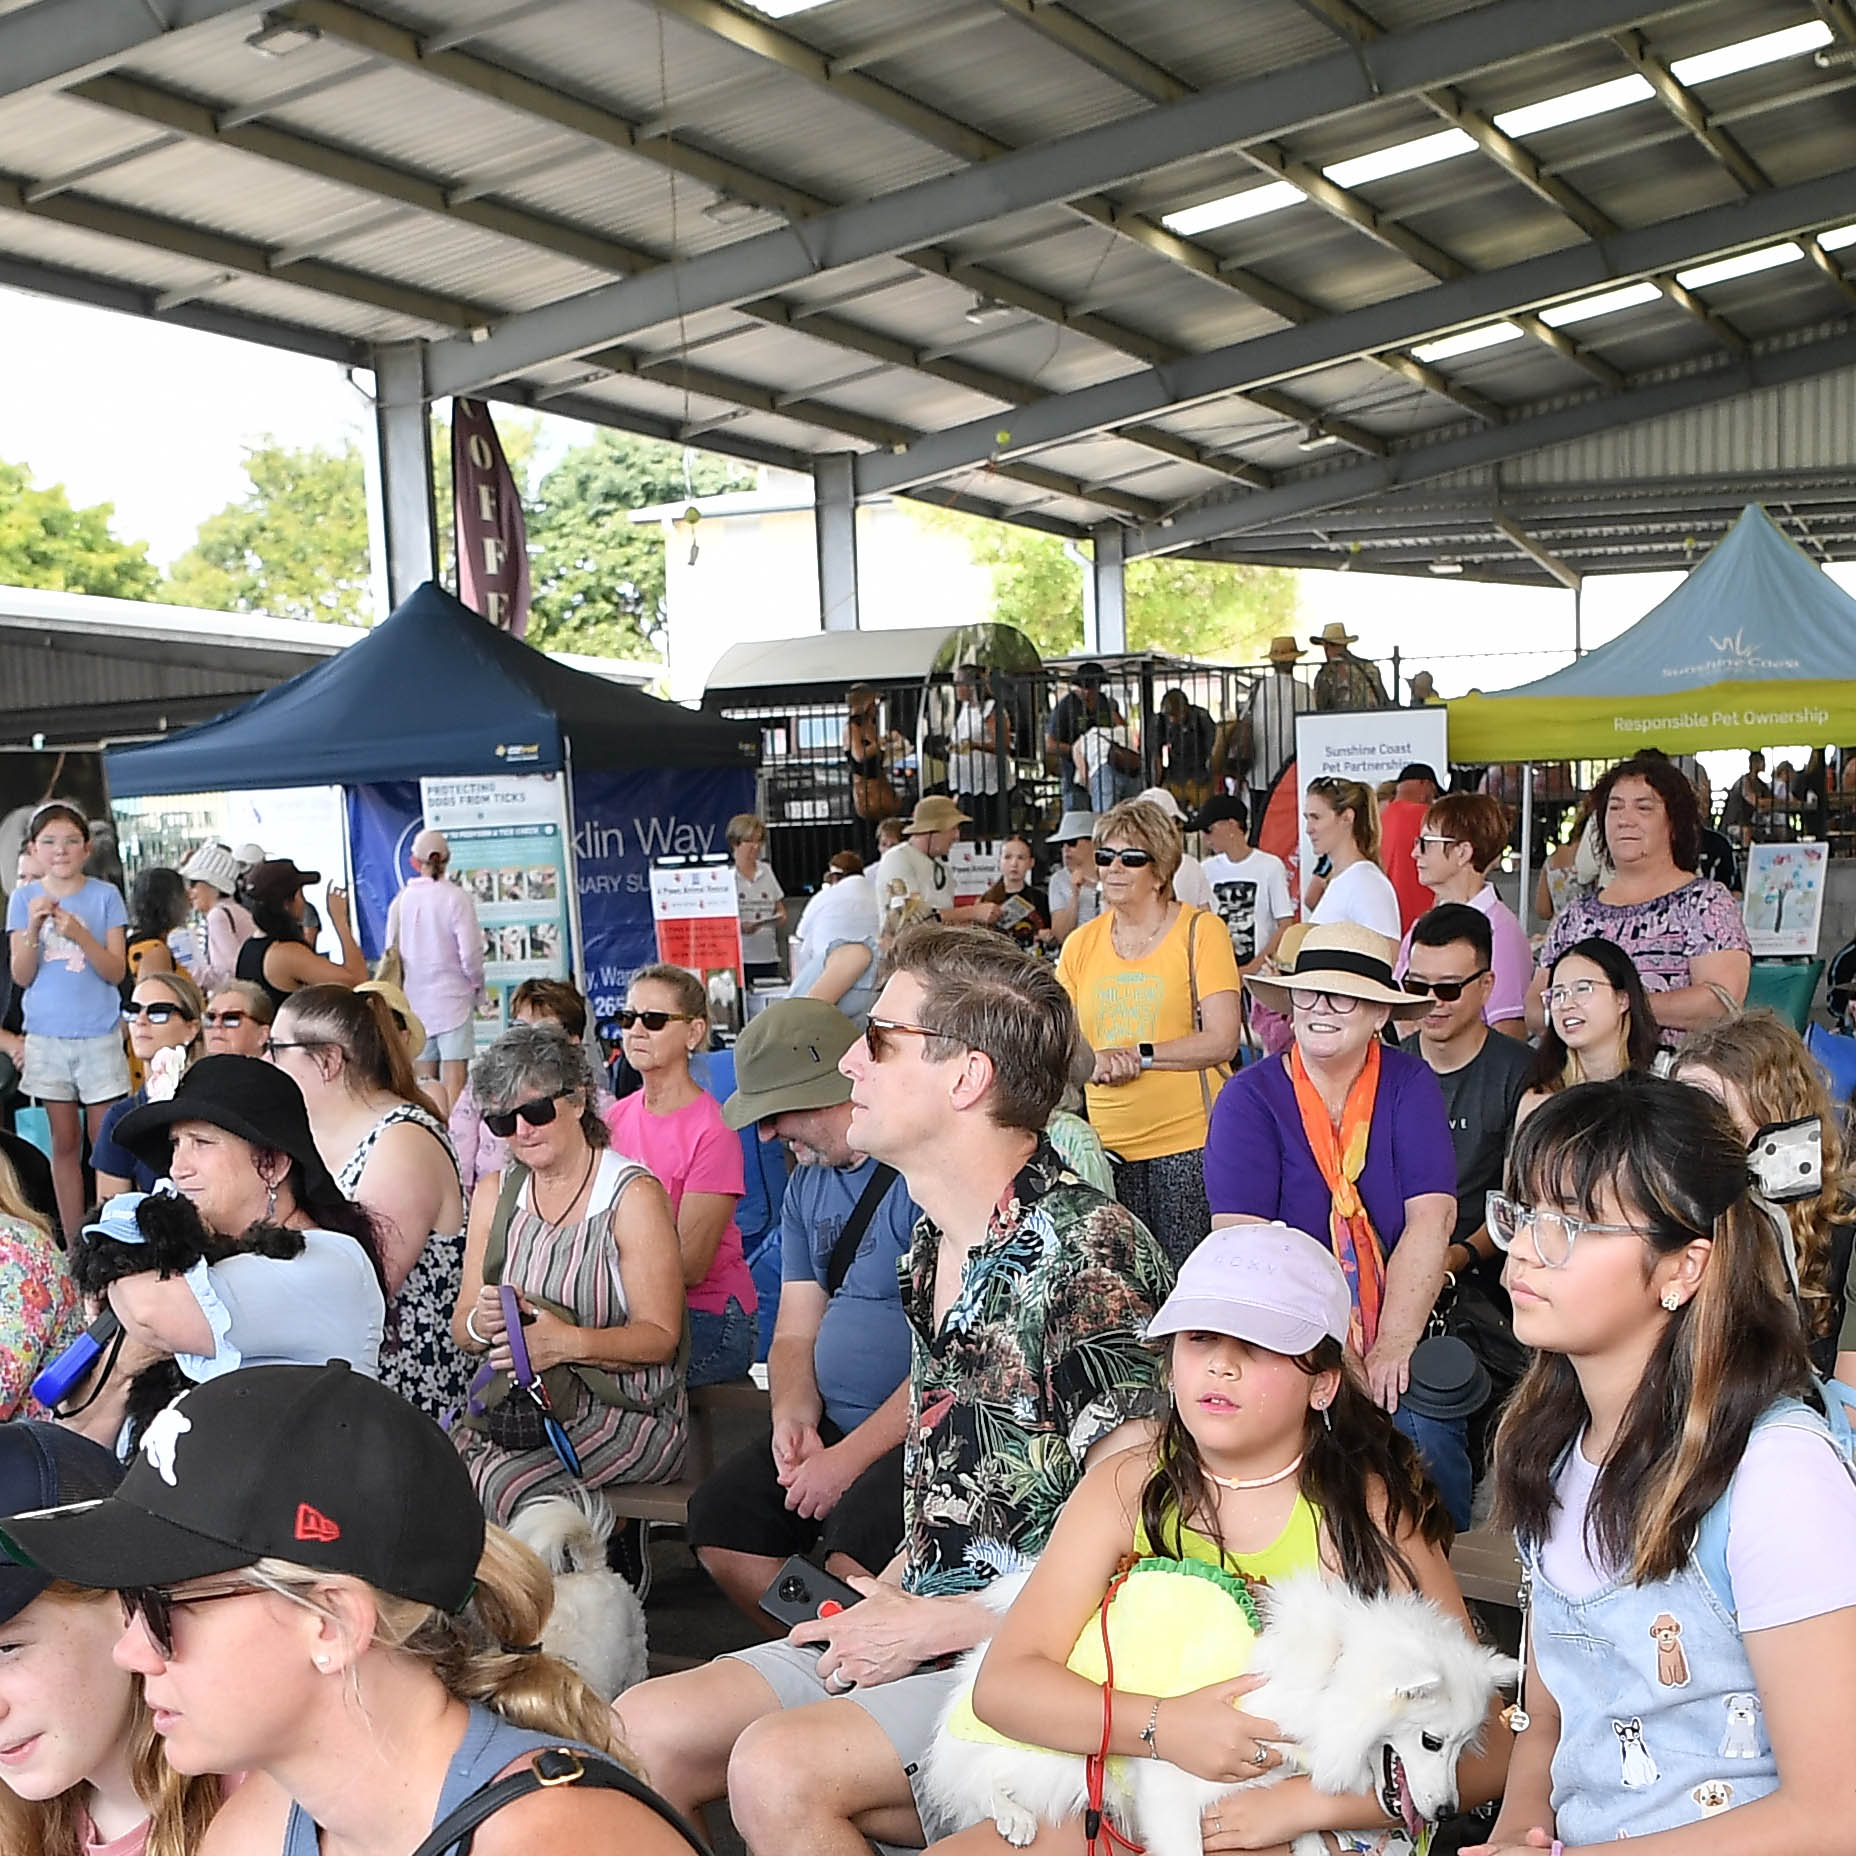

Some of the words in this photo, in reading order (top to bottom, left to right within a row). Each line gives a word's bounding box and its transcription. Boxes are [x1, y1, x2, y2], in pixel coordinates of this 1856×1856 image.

[1662, 658, 1744, 678] Sunshine
[1748, 656, 1800, 670] Coast
[1613, 713, 1708, 733] Responsible
[1712, 711, 1740, 727] Pet
[1744, 706, 1830, 727] Ownership
[1324, 744, 1376, 758] Sunshine
[1379, 743, 1412, 755] Coast
[1322, 761, 1341, 773] Pet
[427, 783, 496, 795] PROTECTING
[428, 797, 456, 807] DOGS
[459, 794, 490, 805] FROM
[494, 792, 526, 803] TICKS
[634, 815, 716, 855] Way
